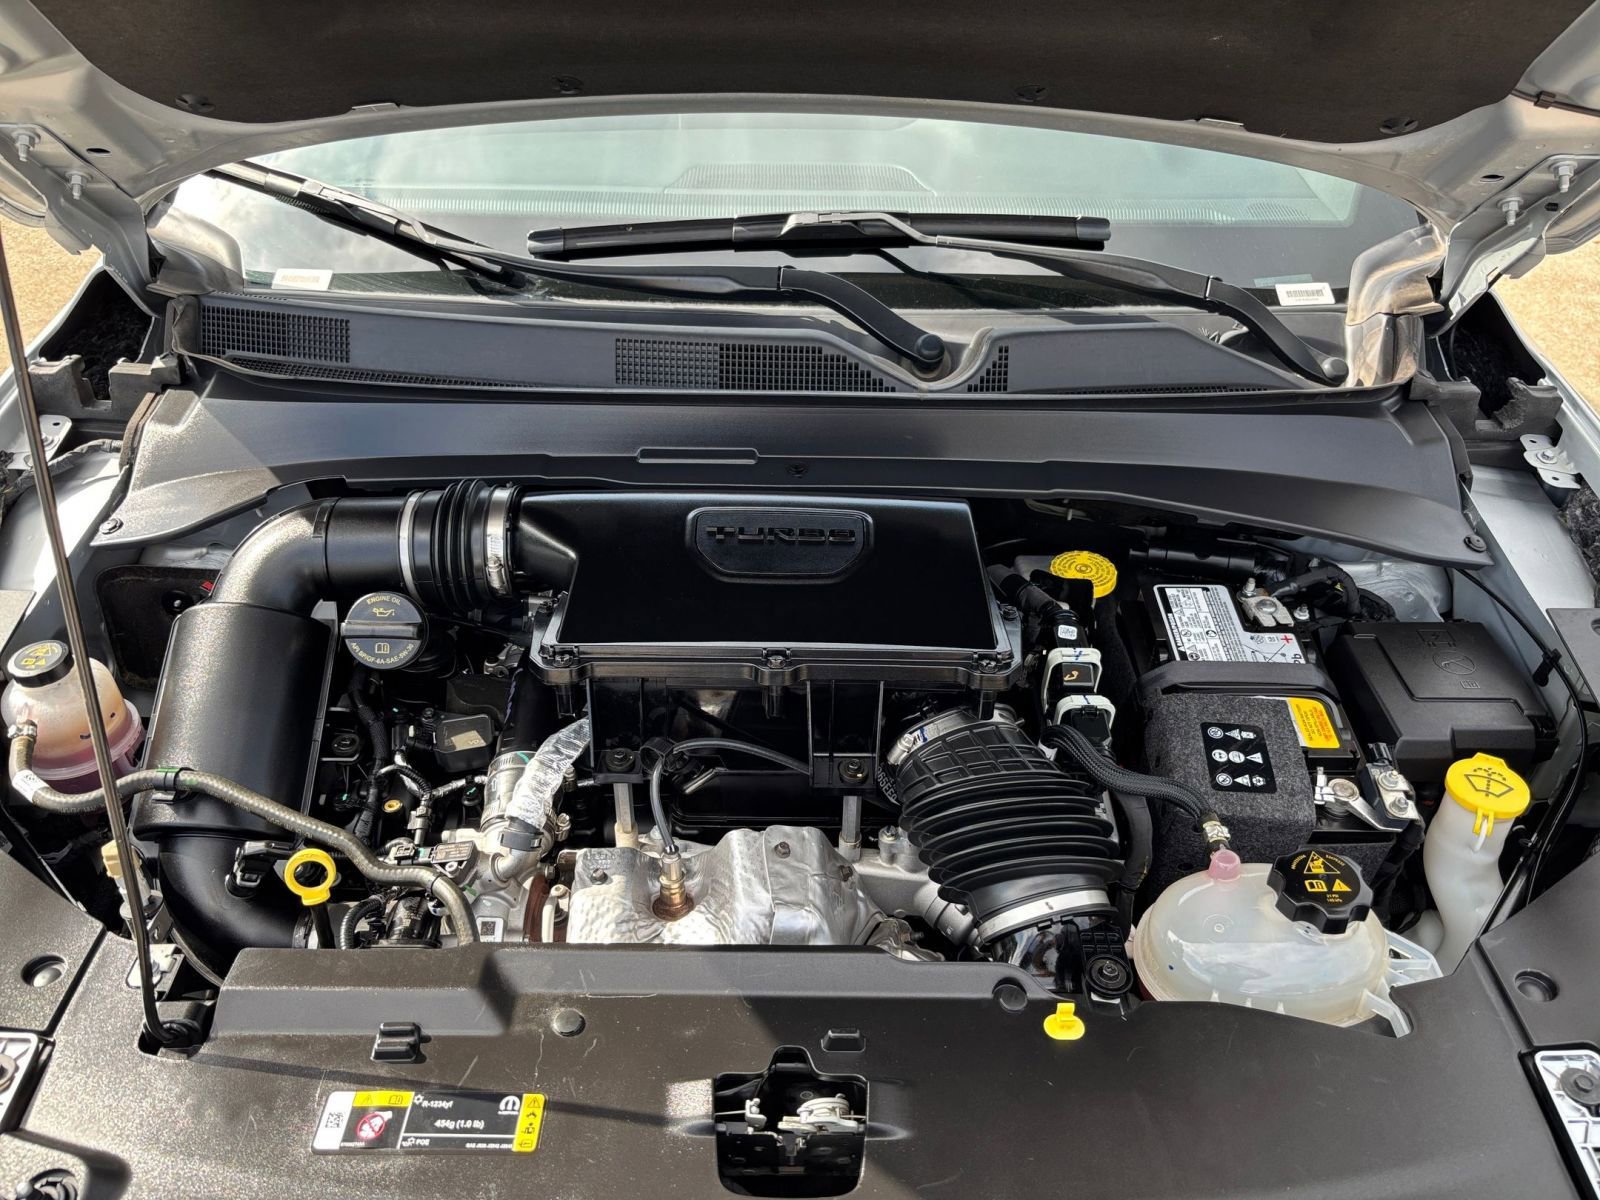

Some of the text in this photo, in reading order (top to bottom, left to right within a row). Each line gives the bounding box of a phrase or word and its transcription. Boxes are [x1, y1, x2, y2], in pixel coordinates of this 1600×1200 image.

[366, 595, 401, 606] ENGINE OIL
[434, 1119, 455, 1129] 454g
